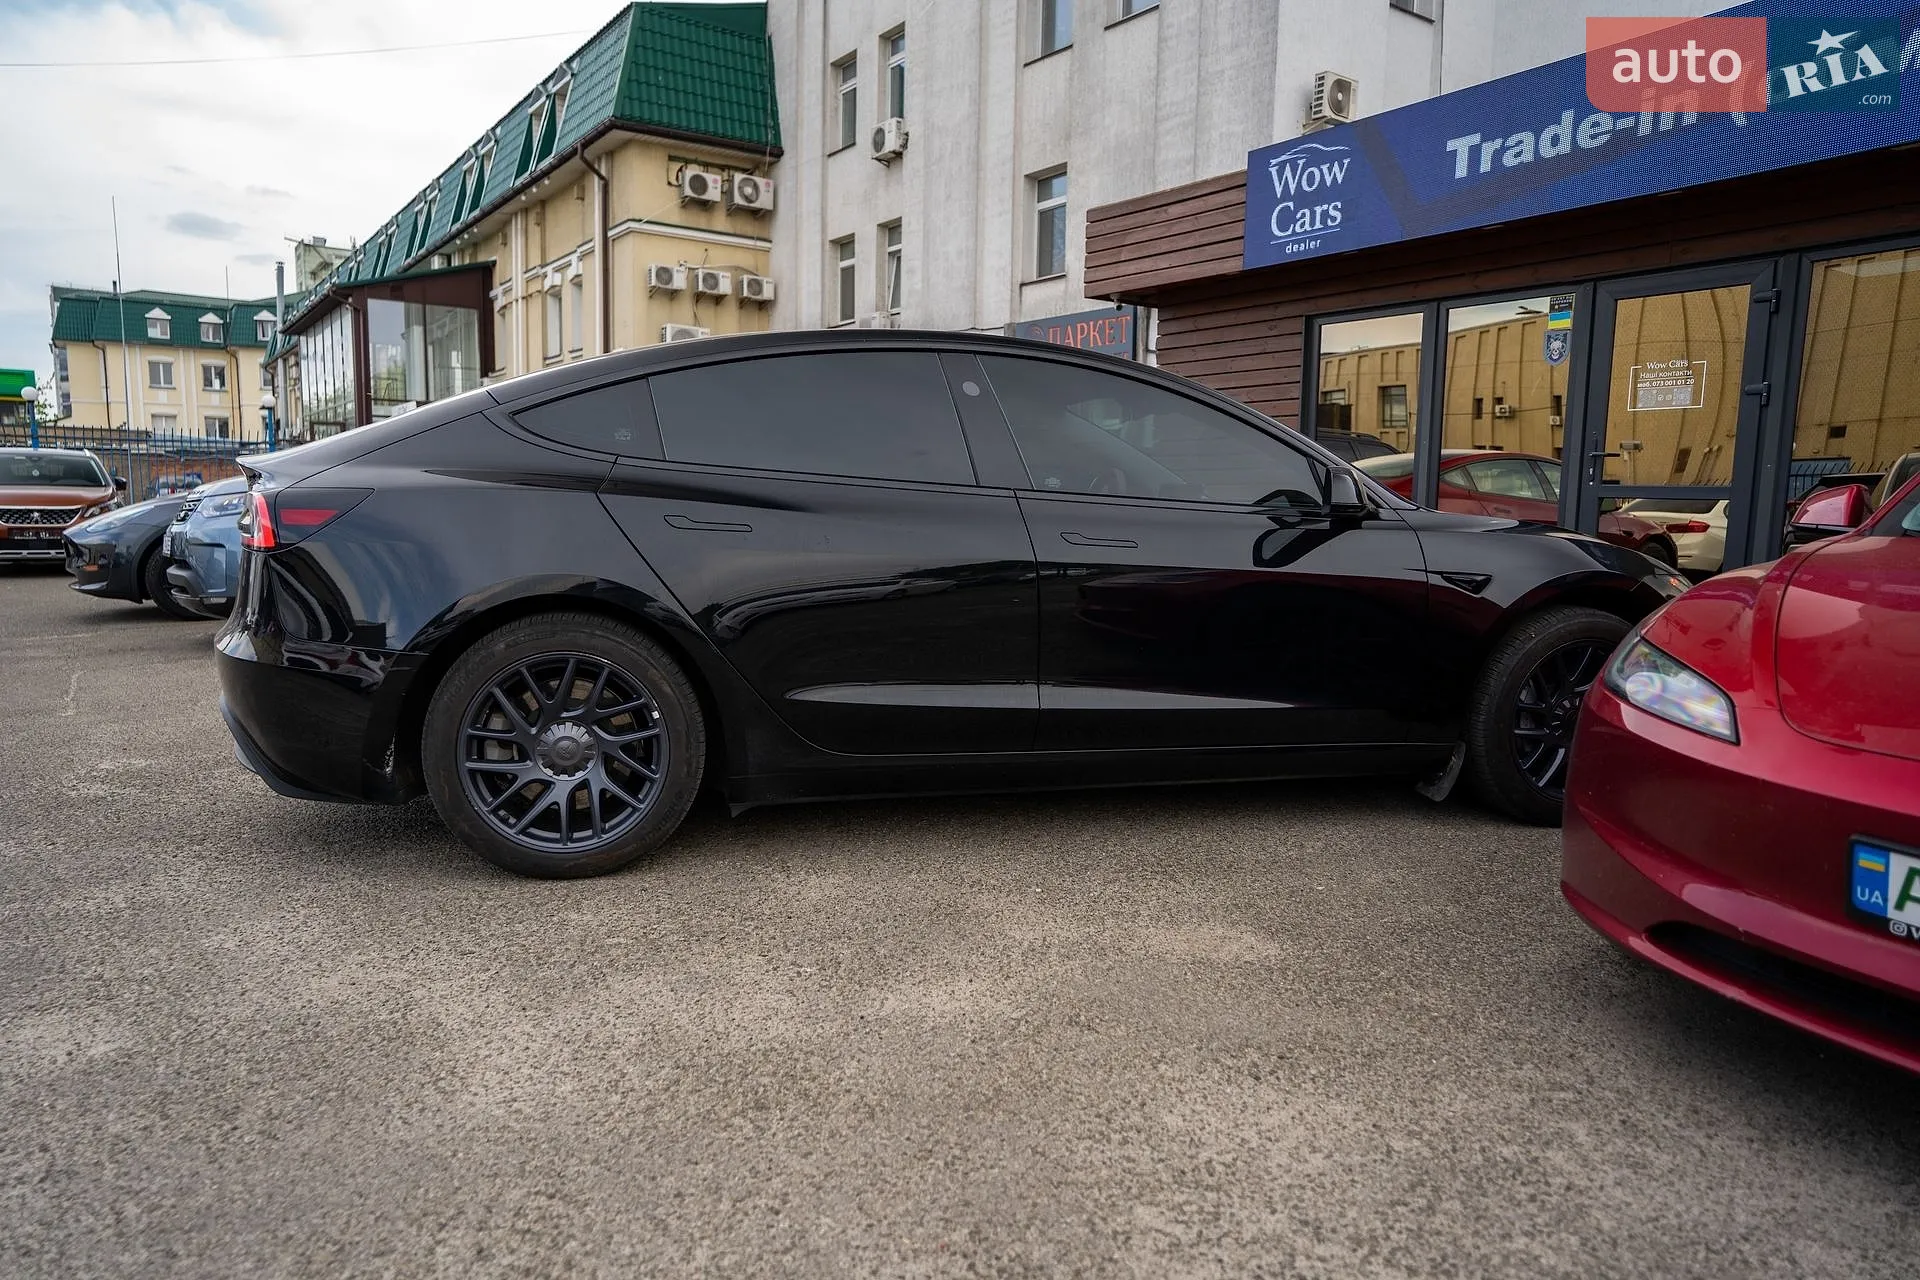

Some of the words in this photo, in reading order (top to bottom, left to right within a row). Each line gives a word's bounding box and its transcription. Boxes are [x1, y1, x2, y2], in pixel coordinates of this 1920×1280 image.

[1446, 86, 1699, 180] Trade-in
[1268, 157, 1351, 199] Wow
[1271, 201, 1342, 237] Cars
[1285, 239, 1321, 254] dealer
[1048, 315, 1131, 350] ПАРКЕТ
[1640, 371, 1657, 379] Наші
[1659, 370, 1693, 378] контакти
[1646, 361, 1667, 370] Wow
[1669, 359, 1689, 369] Cars
[1856, 885, 1884, 907] UA
